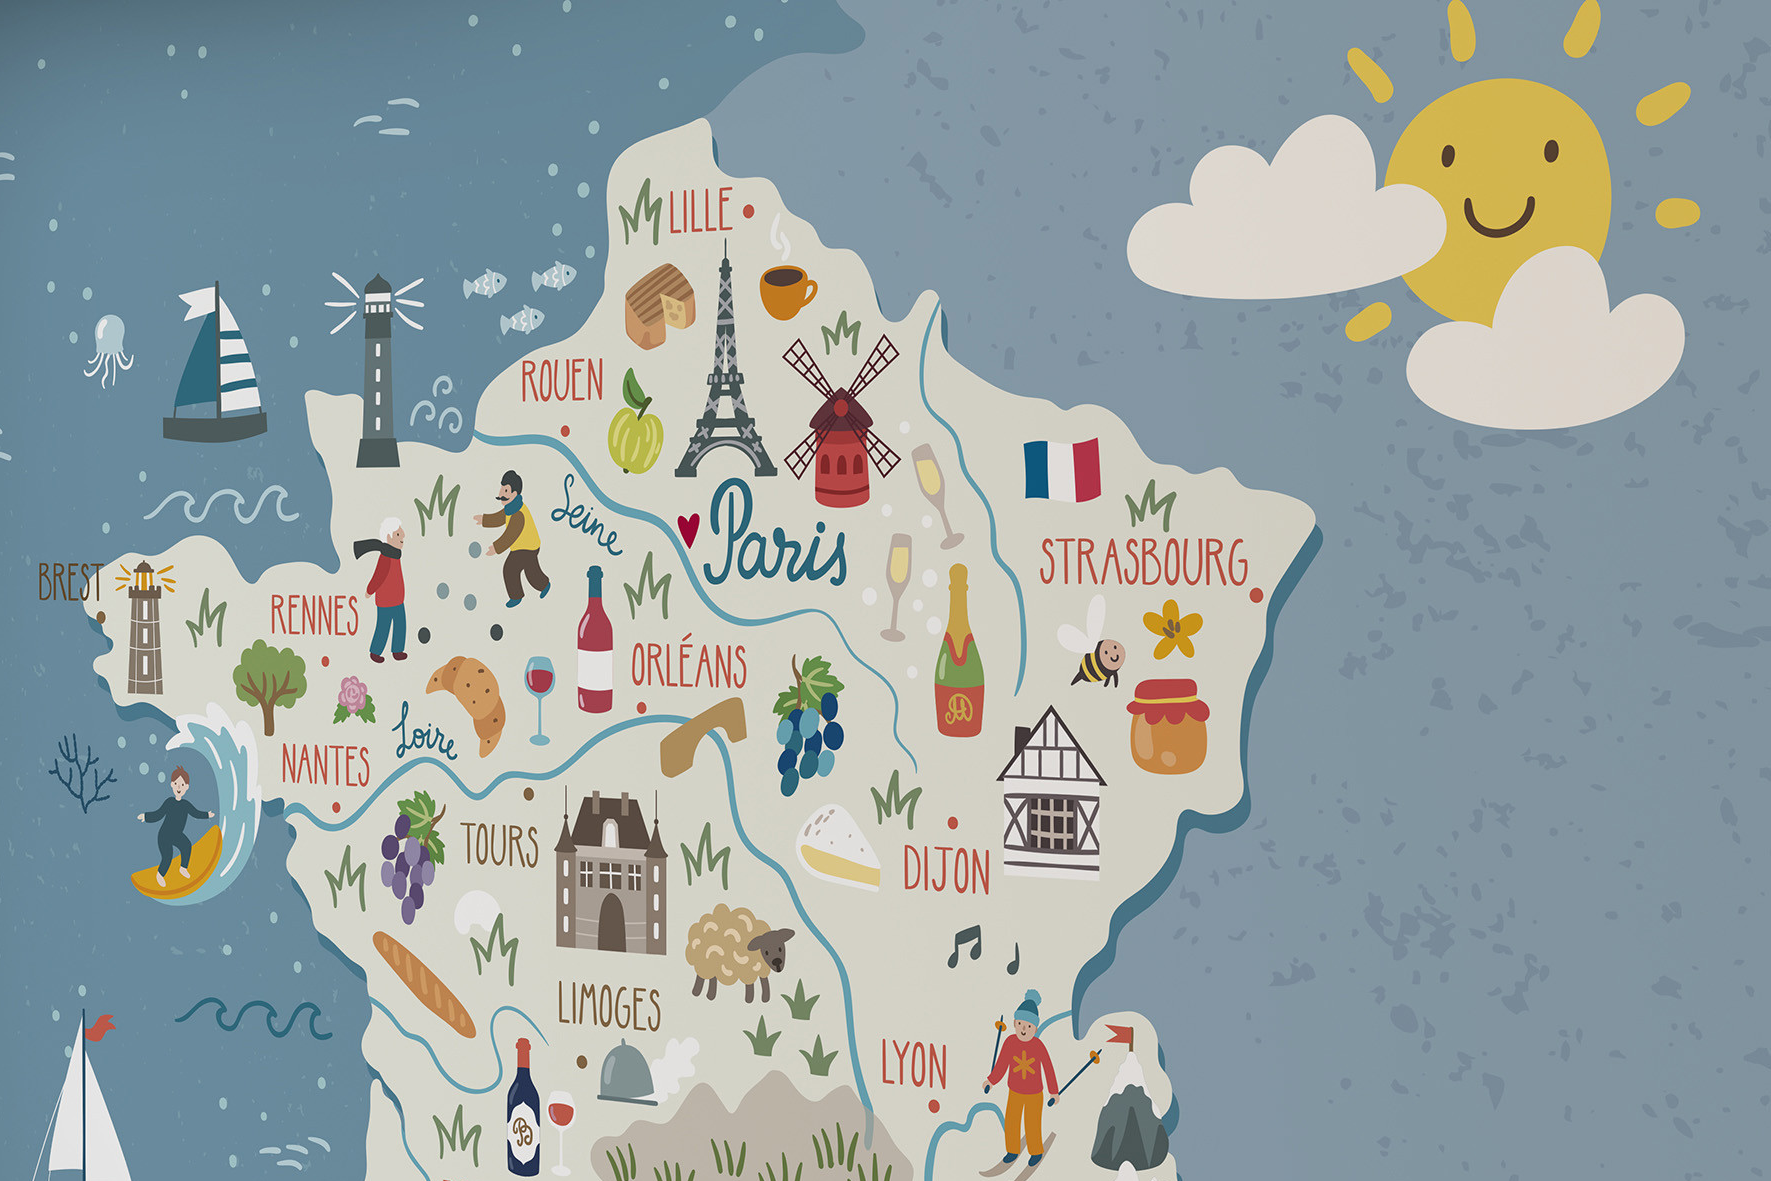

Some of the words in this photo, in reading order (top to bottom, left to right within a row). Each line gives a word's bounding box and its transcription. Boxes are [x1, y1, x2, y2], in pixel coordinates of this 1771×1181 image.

[669, 187, 733, 234] LILLE
[521, 357, 604, 403] ROUEN
[551, 473, 623, 557] Seine
[703, 477, 848, 587] Paris
[38, 562, 105, 603] BREST
[1039, 537, 1249, 587] STRASBOURG
[271, 594, 359, 637] RENNES
[631, 632, 747, 690] ORLÉANS
[391, 700, 459, 761] Loire
[282, 743, 370, 788] NANTES
[459, 822, 539, 869] TOURS
[903, 844, 990, 896] DIJON
[558, 980, 662, 1033] LIMOGES
[881, 1039, 947, 1090] LYON
